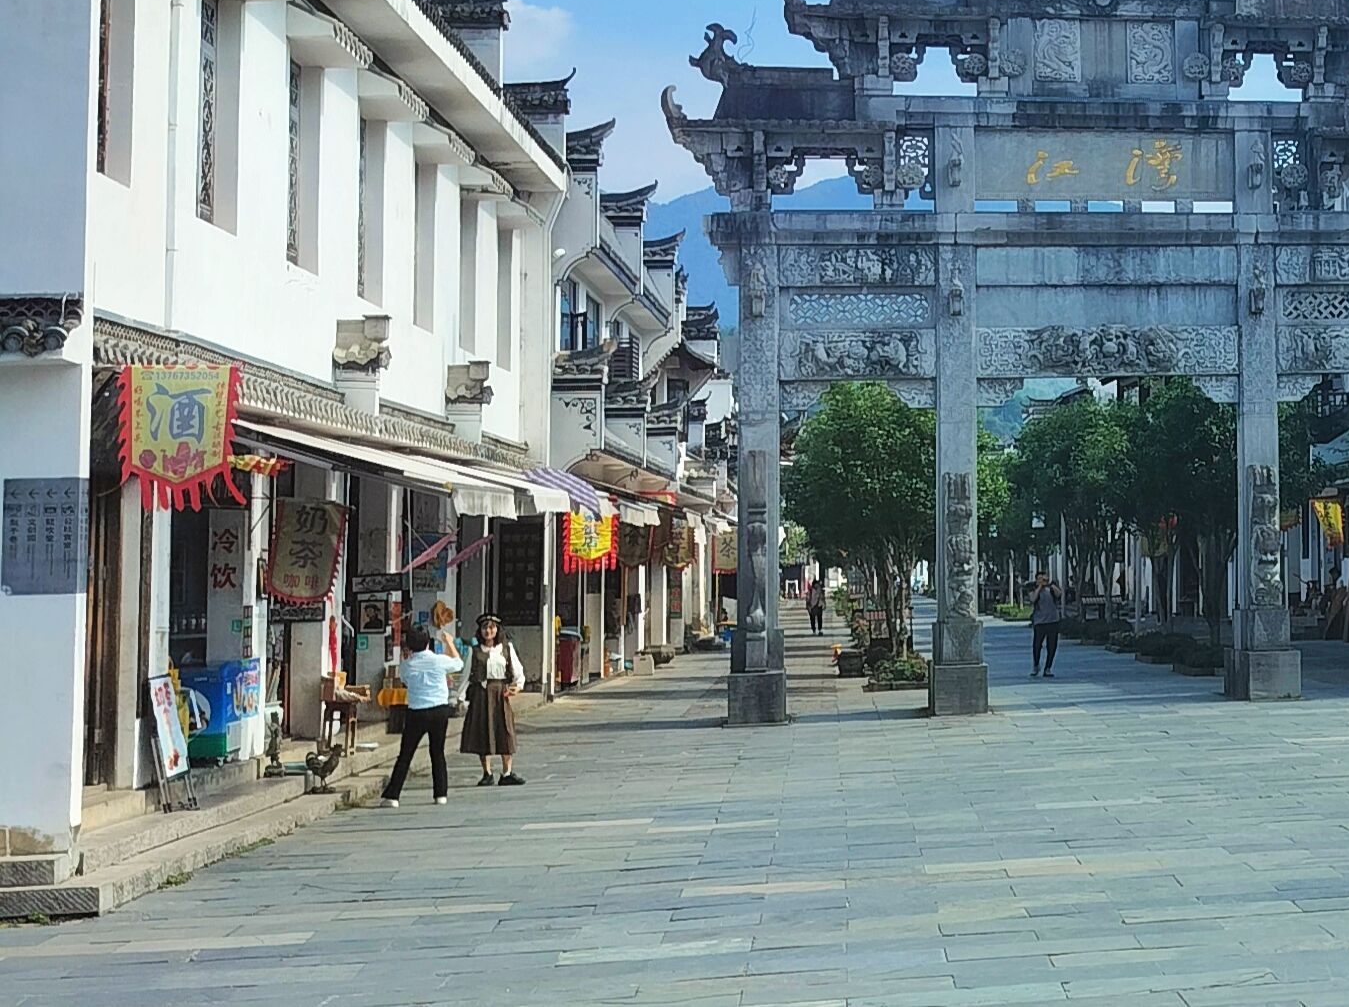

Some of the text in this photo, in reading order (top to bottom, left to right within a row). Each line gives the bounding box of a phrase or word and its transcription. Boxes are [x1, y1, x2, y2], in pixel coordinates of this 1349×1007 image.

[145, 382, 213, 444] 酒
[210, 528, 239, 590] 冷饮
[289, 505, 329, 569] 奶茶
[719, 539, 737, 559] 茶
[283, 573, 320, 589] 咖啡
